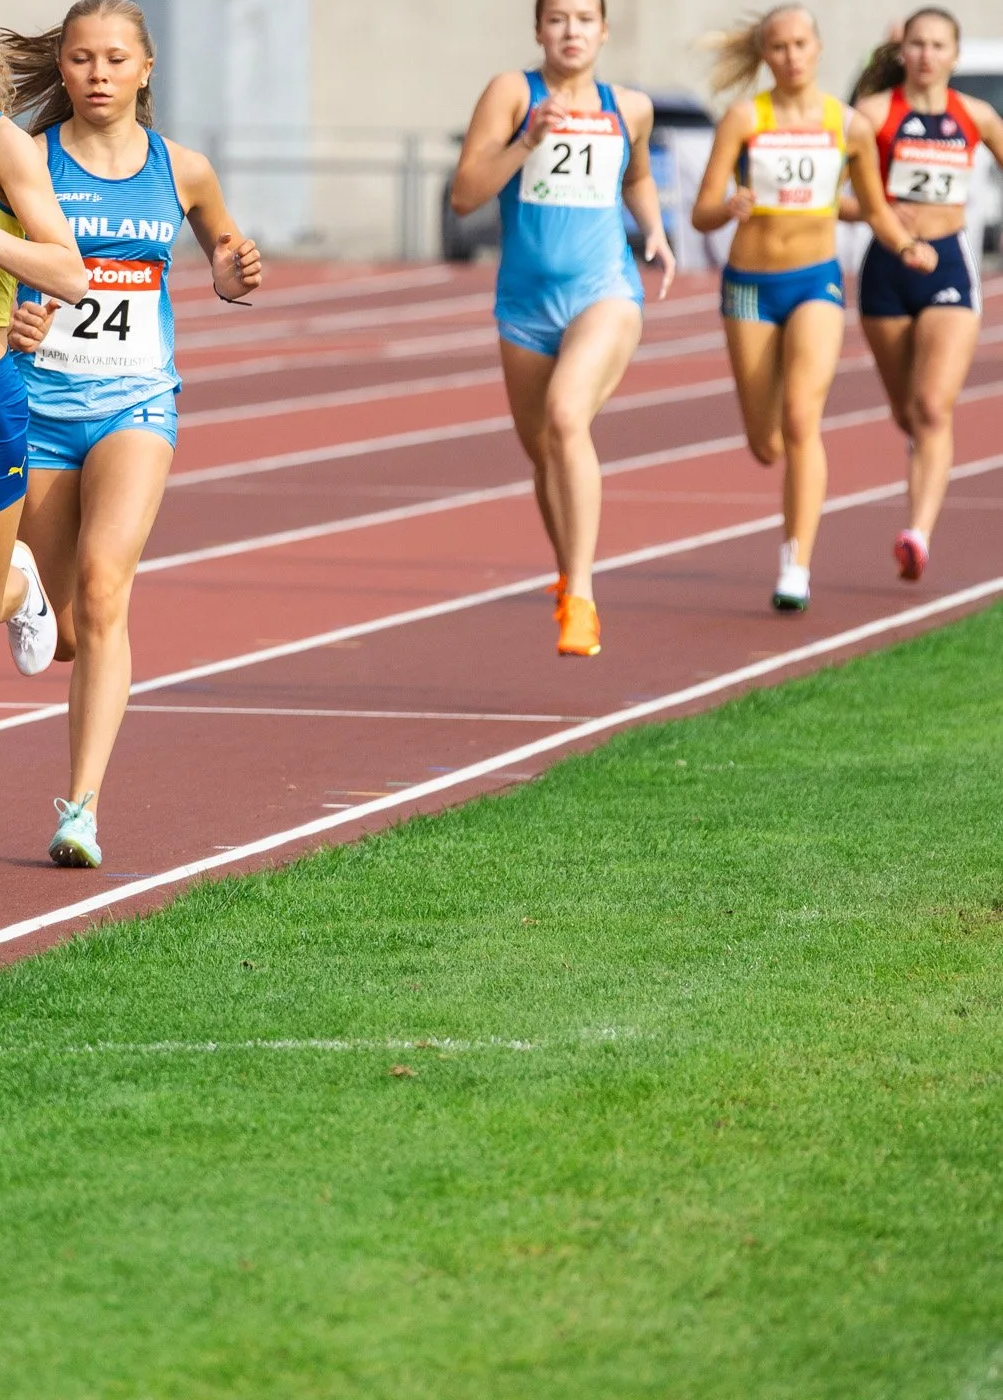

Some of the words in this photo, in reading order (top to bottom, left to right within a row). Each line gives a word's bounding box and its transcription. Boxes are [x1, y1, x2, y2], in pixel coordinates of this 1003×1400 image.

[551, 143, 592, 175] 21
[777, 157, 814, 184] 30
[56, 192, 93, 201] CRAFT
[909, 170, 954, 197] 23
[68, 217, 174, 243] INLAND
[85, 266, 152, 283] tonet
[72, 298, 130, 341] 24
[42, 349, 69, 361] LAPIN
